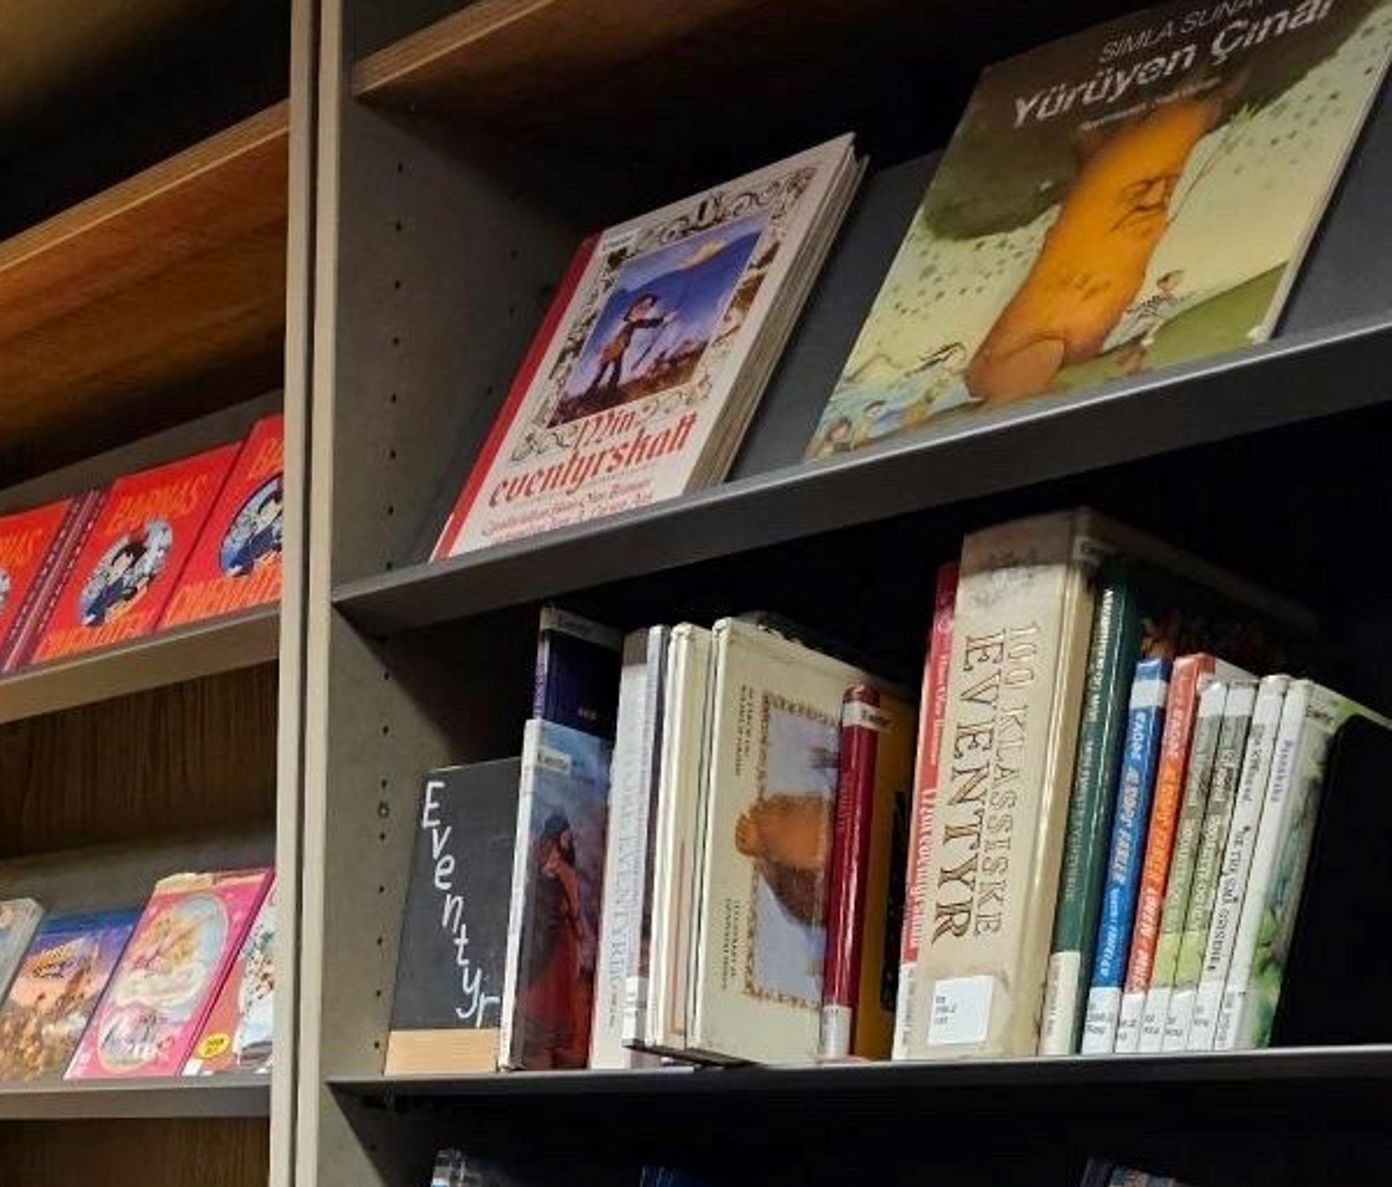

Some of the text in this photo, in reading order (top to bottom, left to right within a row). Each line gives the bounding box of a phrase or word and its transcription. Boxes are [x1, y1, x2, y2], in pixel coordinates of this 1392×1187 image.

[1013, 41, 1198, 128] Yürüyen
[421, 780, 502, 1028] Eventyr
[931, 634, 1007, 946] EVENTYR
[972, 619, 1039, 937] 100 KLASSISKE
